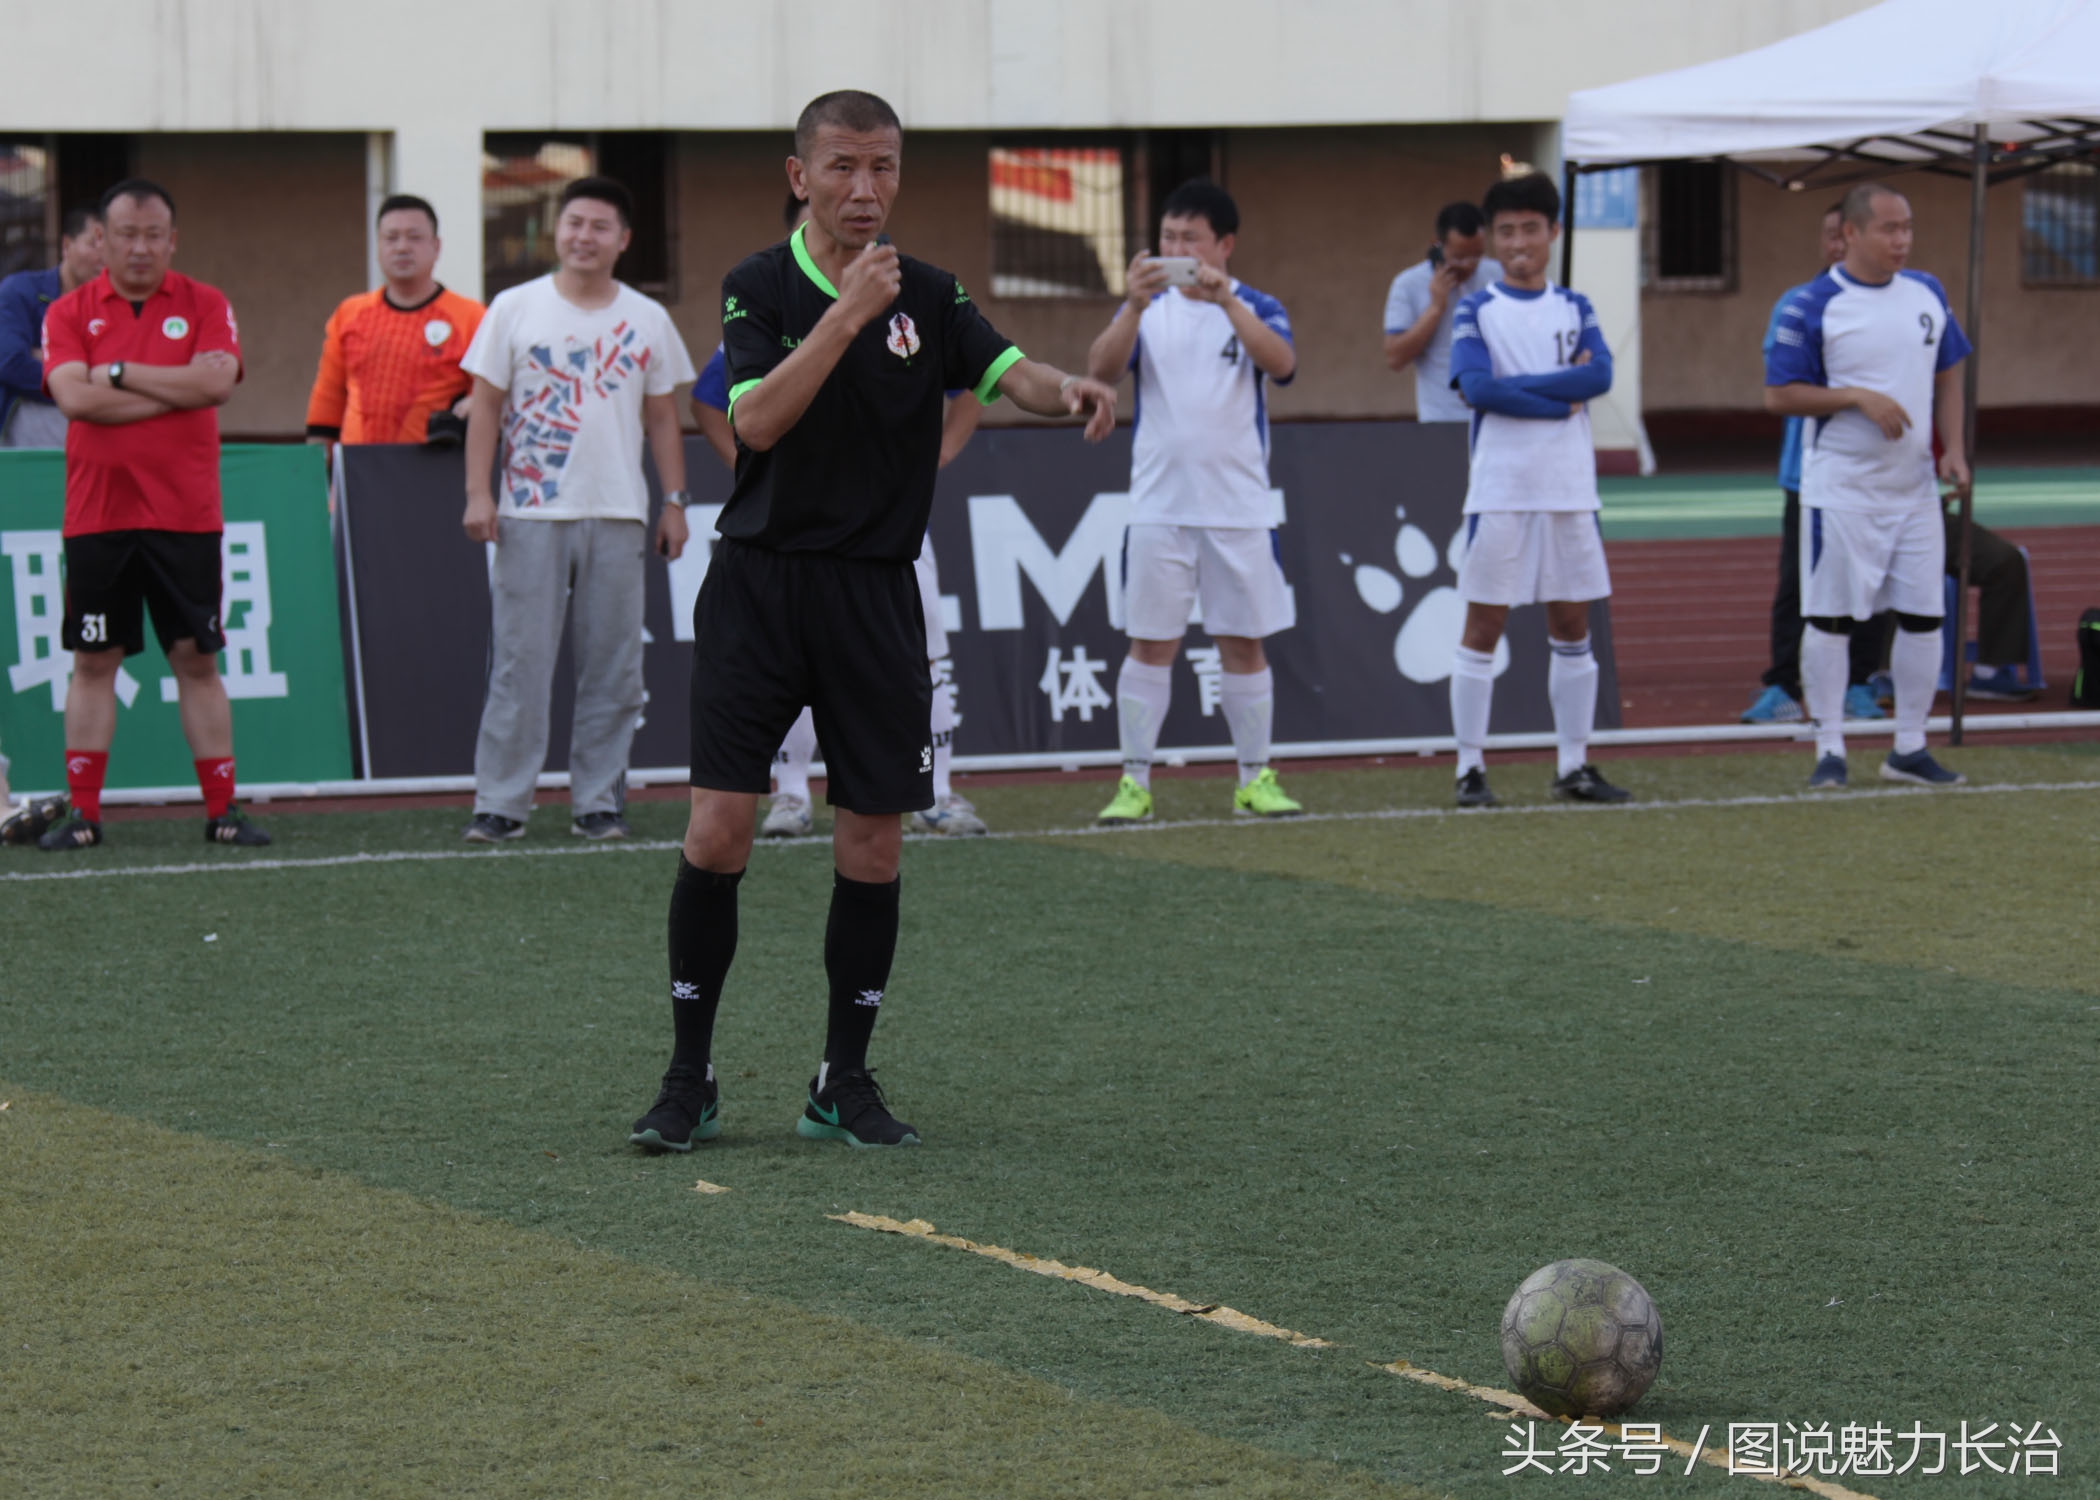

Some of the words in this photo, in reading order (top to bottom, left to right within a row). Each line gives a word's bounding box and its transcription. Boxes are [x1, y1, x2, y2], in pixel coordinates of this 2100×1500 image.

[1919, 312, 1936, 346] 2
[1220, 333, 1239, 366] 4
[81, 613, 107, 642] 31
